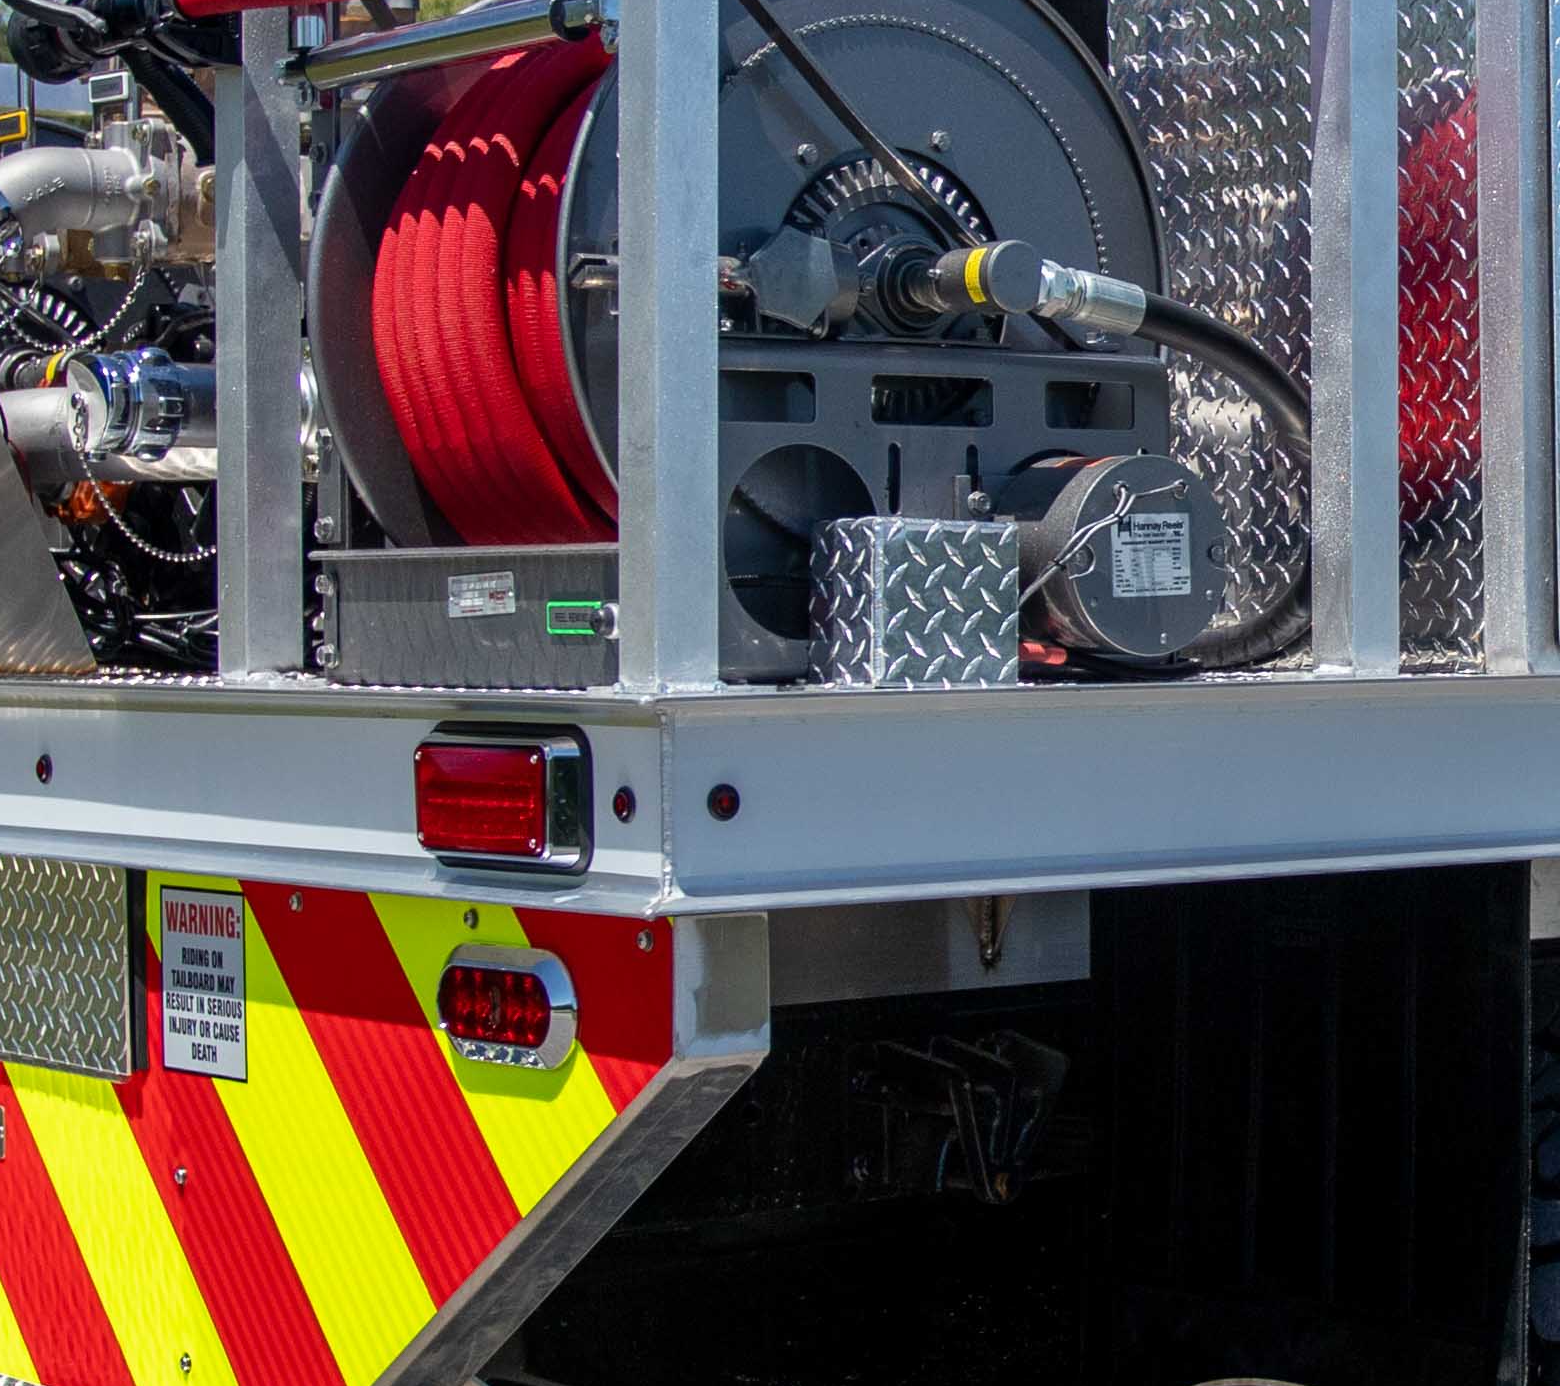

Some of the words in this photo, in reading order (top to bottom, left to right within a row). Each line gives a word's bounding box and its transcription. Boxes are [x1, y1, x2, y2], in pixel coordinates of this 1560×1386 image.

[165, 900, 241, 940] WARNING:
[181, 947, 210, 968] RIDING
[211, 950, 224, 969] ON
[171, 969, 216, 993] TAILBOARD
[217, 975, 236, 995] MAY
[166, 991, 194, 1014] RESULT
[196, 996, 205, 1014] IN
[207, 999, 243, 1020] SERIOUS
[169, 1016, 197, 1036] INJURY
[199, 1020, 211, 1039] OR
[212, 1023, 240, 1044] CAUSE
[191, 1042, 218, 1063] DEATH
